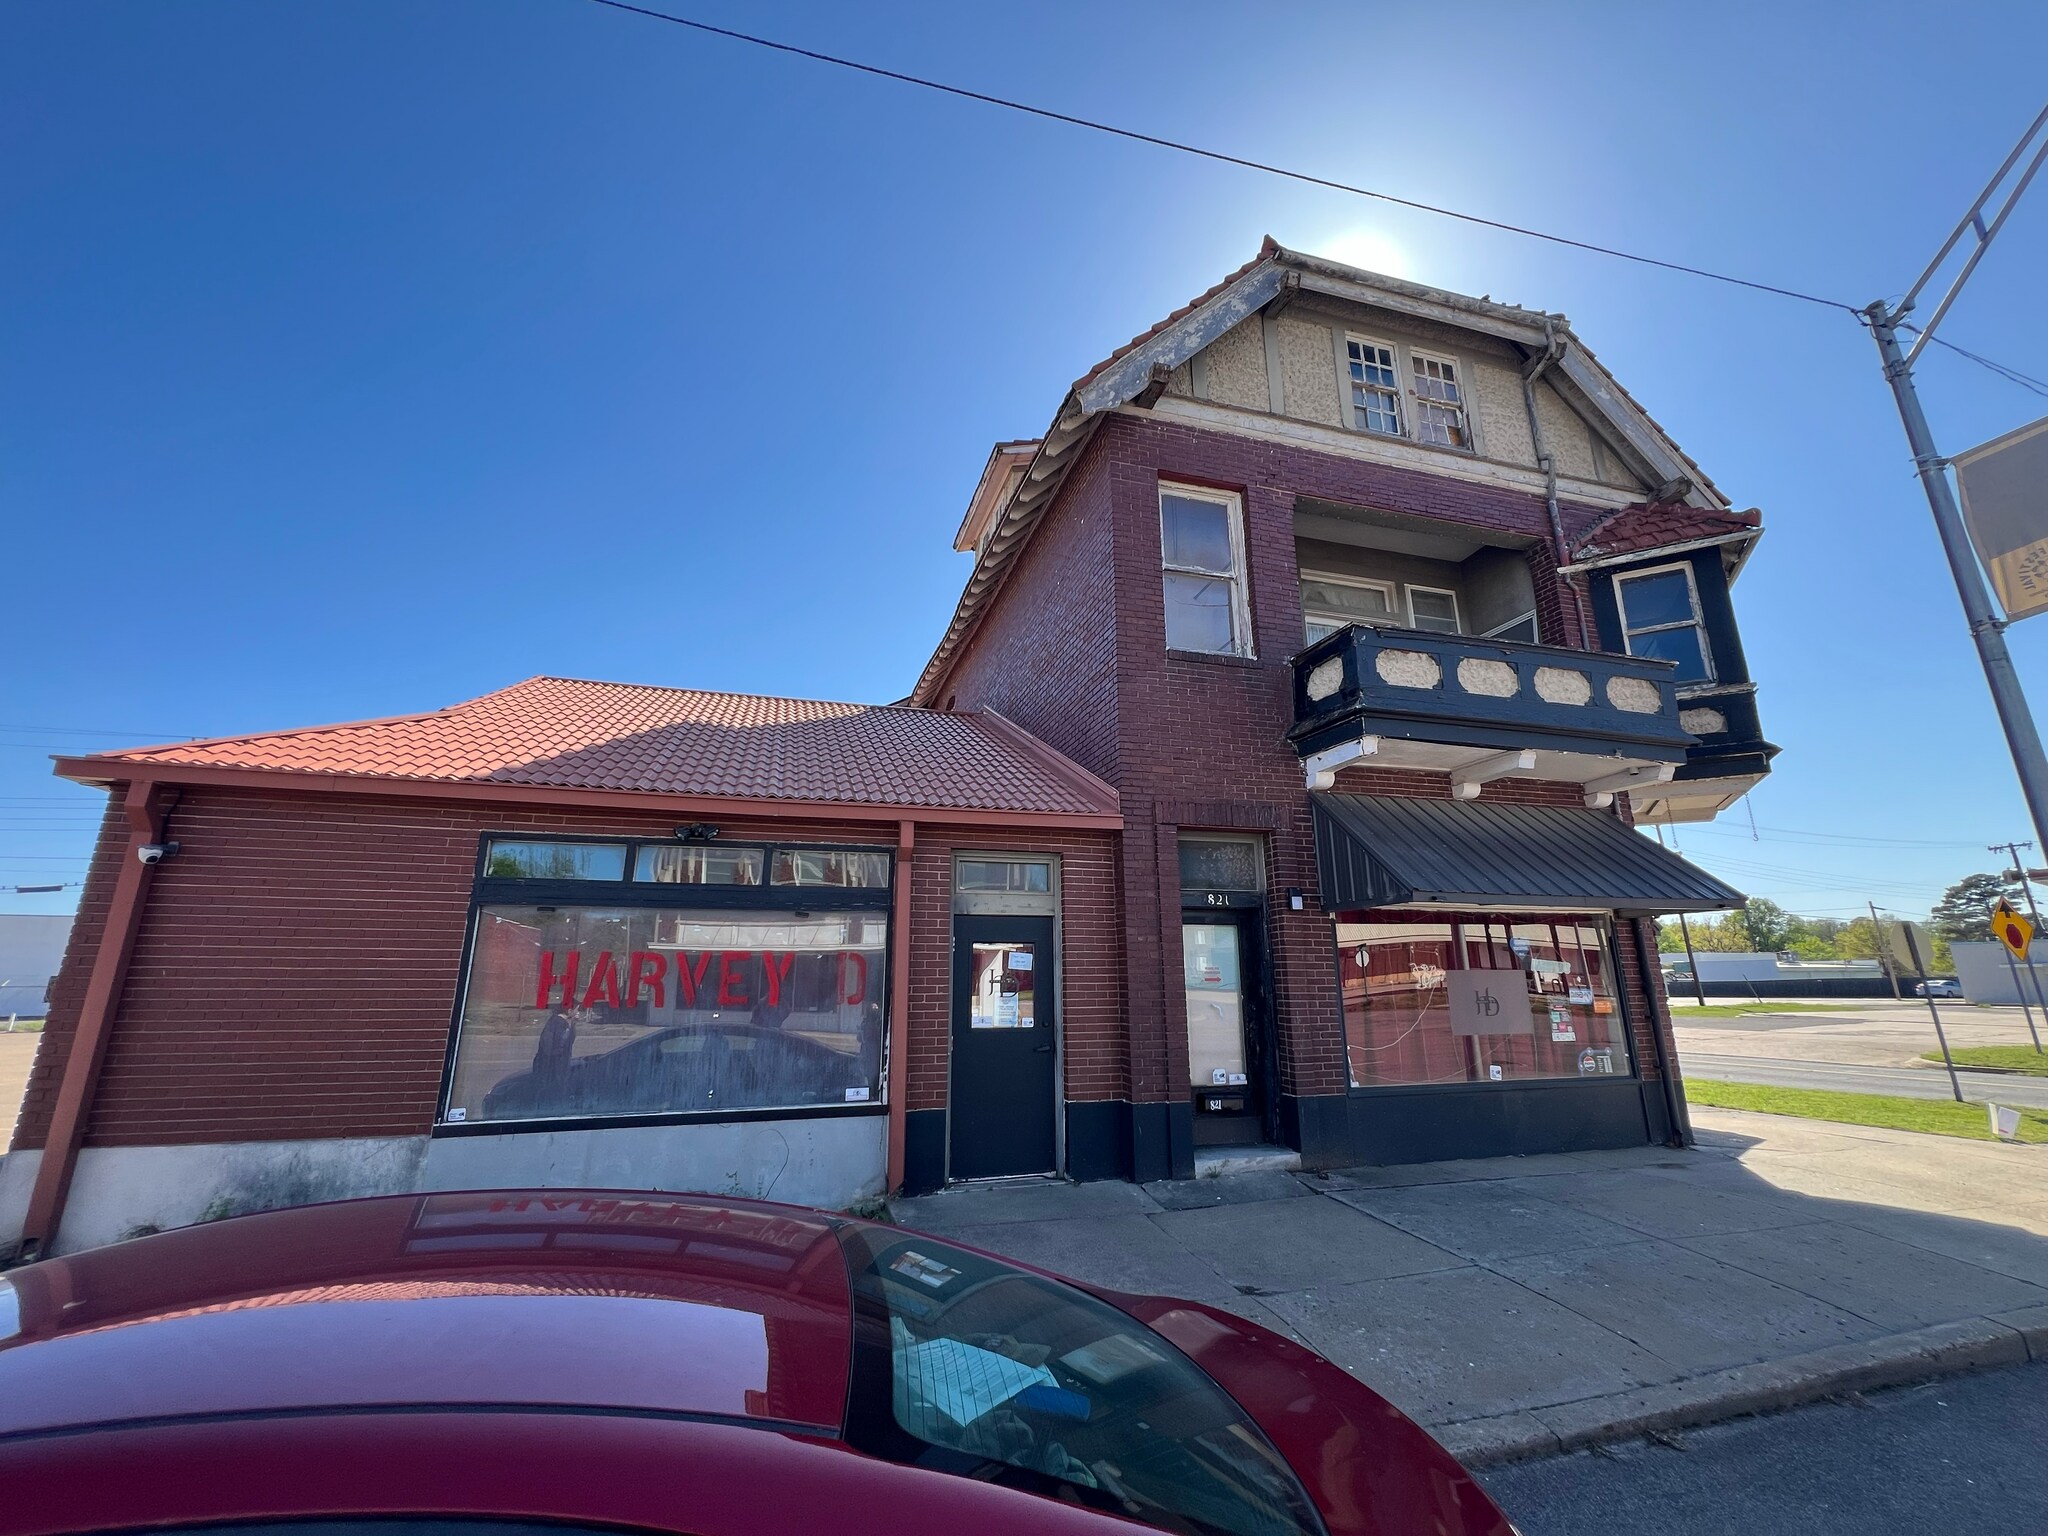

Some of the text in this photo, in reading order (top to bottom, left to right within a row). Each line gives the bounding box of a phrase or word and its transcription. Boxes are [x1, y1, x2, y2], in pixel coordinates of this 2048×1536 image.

[1207, 893, 1230, 906] 821
[535, 950, 868, 1010] HARVEY D
[1210, 1099, 1222, 1111] 821
